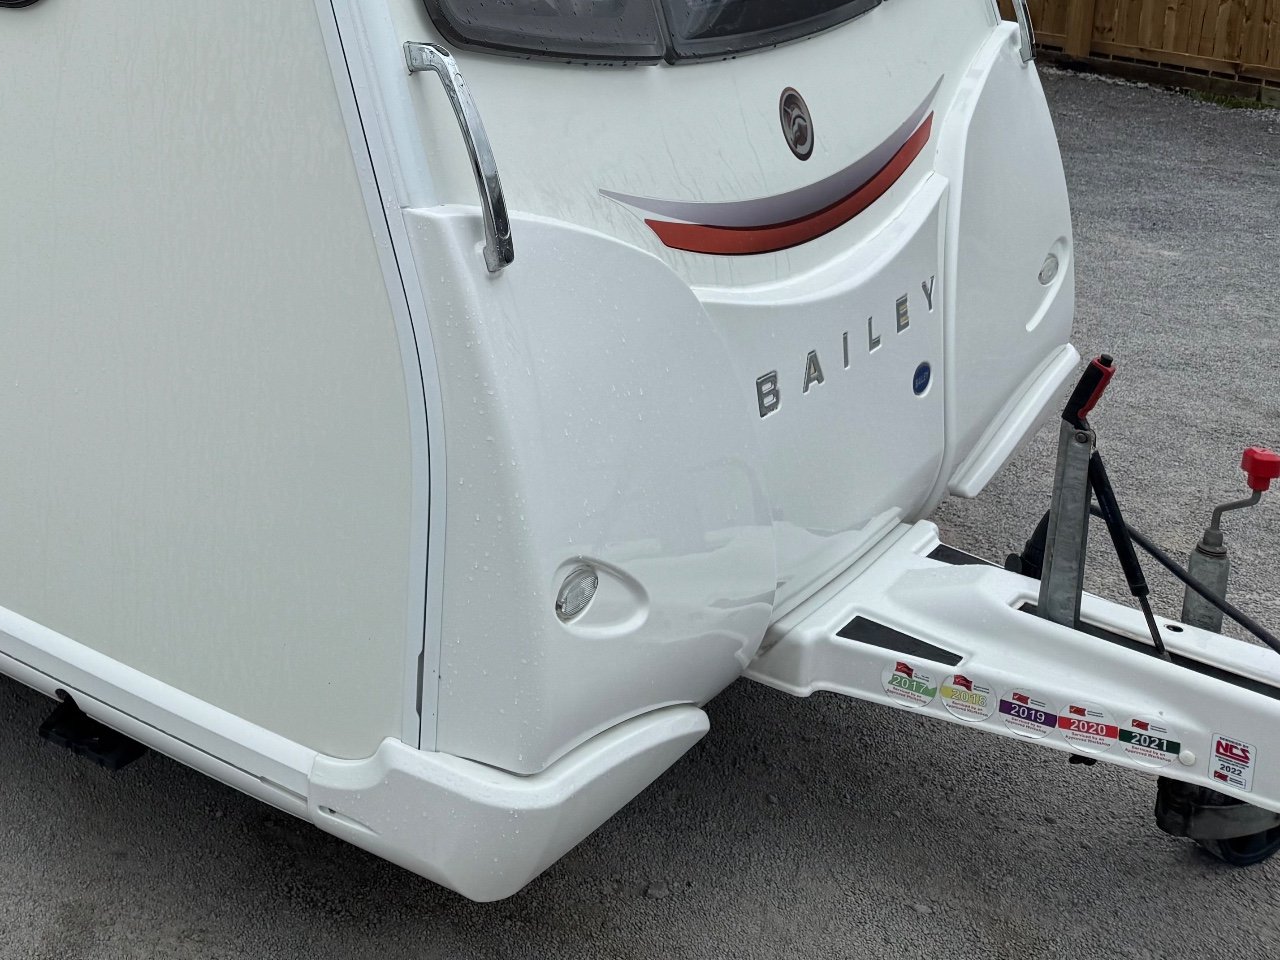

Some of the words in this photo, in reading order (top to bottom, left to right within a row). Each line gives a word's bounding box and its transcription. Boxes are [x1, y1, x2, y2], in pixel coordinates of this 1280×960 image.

[755, 274, 936, 419] BAILEY
[892, 675, 927, 693] 2017
[951, 689, 987, 707] 2018
[1010, 704, 1045, 723] 2019
[1070, 719, 1106, 736] 2020
[1130, 733, 1167, 751] 2021
[1215, 740, 1251, 763] NCS
[1219, 763, 1243, 777] 2022
